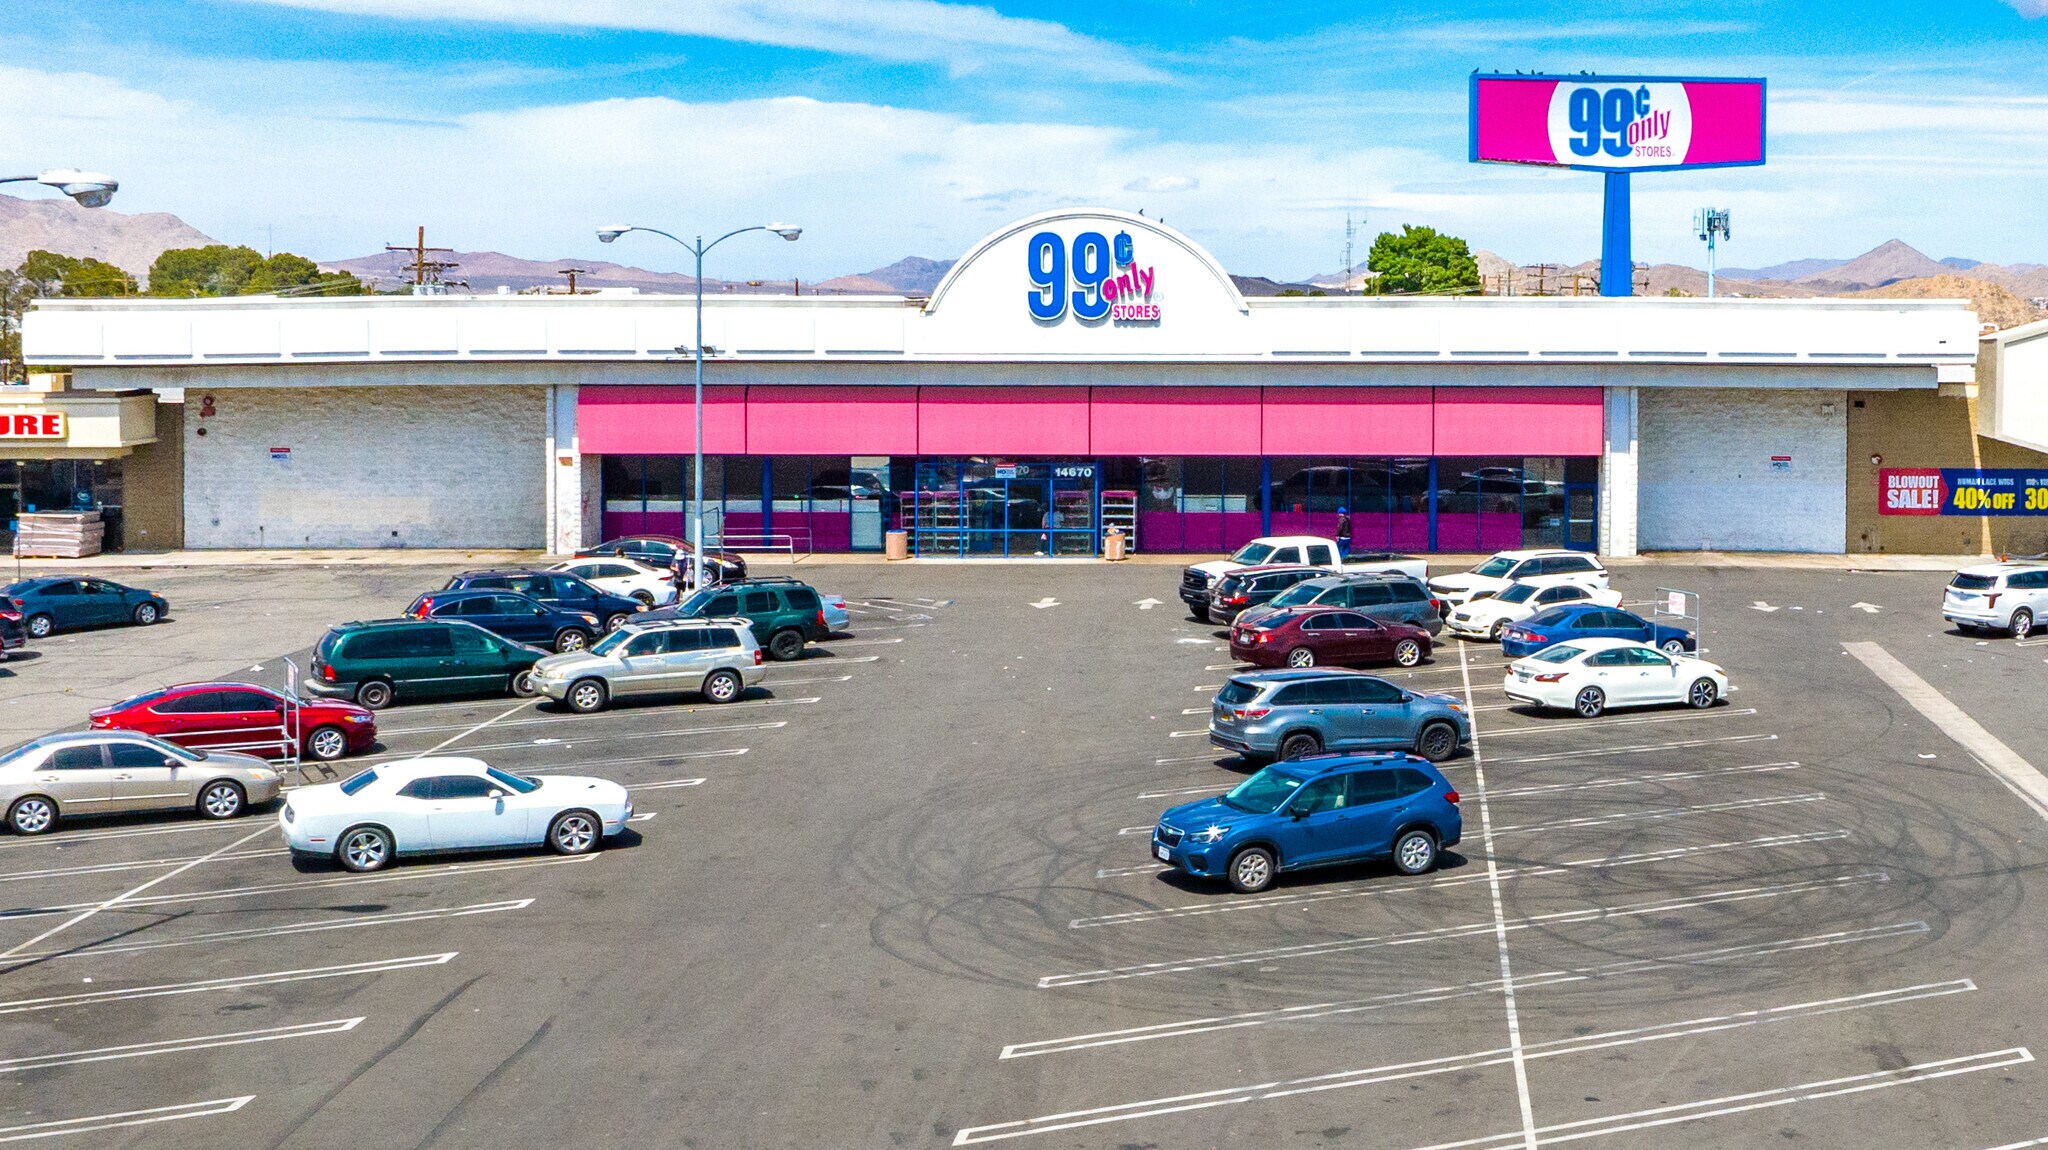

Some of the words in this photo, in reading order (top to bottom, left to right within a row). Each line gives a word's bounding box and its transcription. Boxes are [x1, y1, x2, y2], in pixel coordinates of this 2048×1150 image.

[1628, 109, 1672, 145] only
[1635, 145, 1672, 158] STORES
[1102, 261, 1155, 301] only
[1112, 304, 1160, 319] STORES
[1054, 466, 1092, 477] 14670
[1887, 475, 1940, 489] BLOWOUT
[1981, 477, 1997, 486] LACE
[1998, 477, 2014, 486] WIGS
[1887, 489, 1939, 509] SALE!
[1953, 486, 1991, 510] 40%
[1992, 492, 2016, 510] OFF
